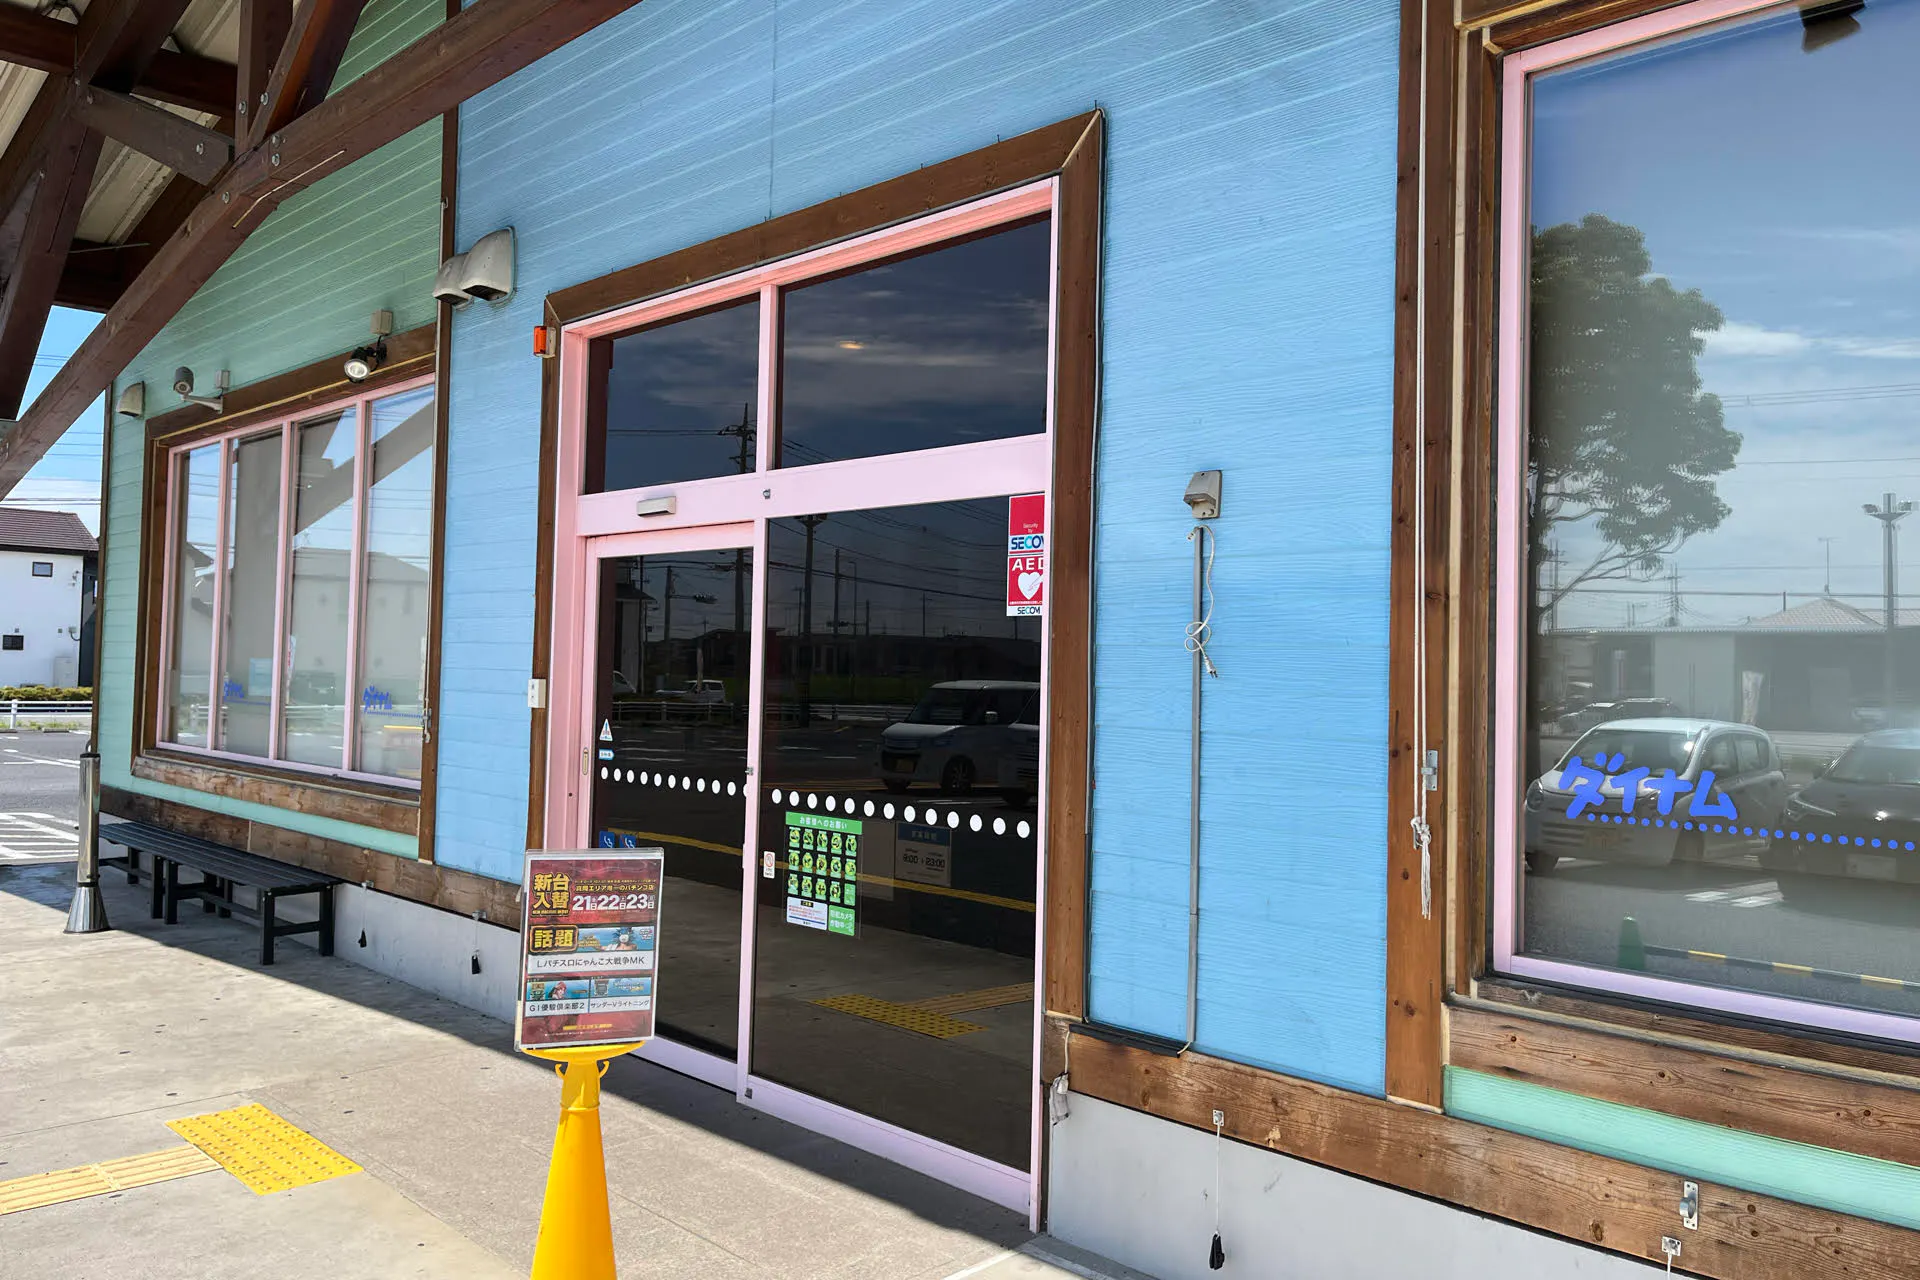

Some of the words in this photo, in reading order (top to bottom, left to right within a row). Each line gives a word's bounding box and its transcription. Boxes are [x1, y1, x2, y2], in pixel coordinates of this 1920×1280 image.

[1011, 535, 1044, 550] SECO
[1559, 752, 1738, 820] ダイナム
[534, 873, 570, 891] 新台
[533, 891, 569, 909] 入替
[534, 929, 574, 948] 話題
